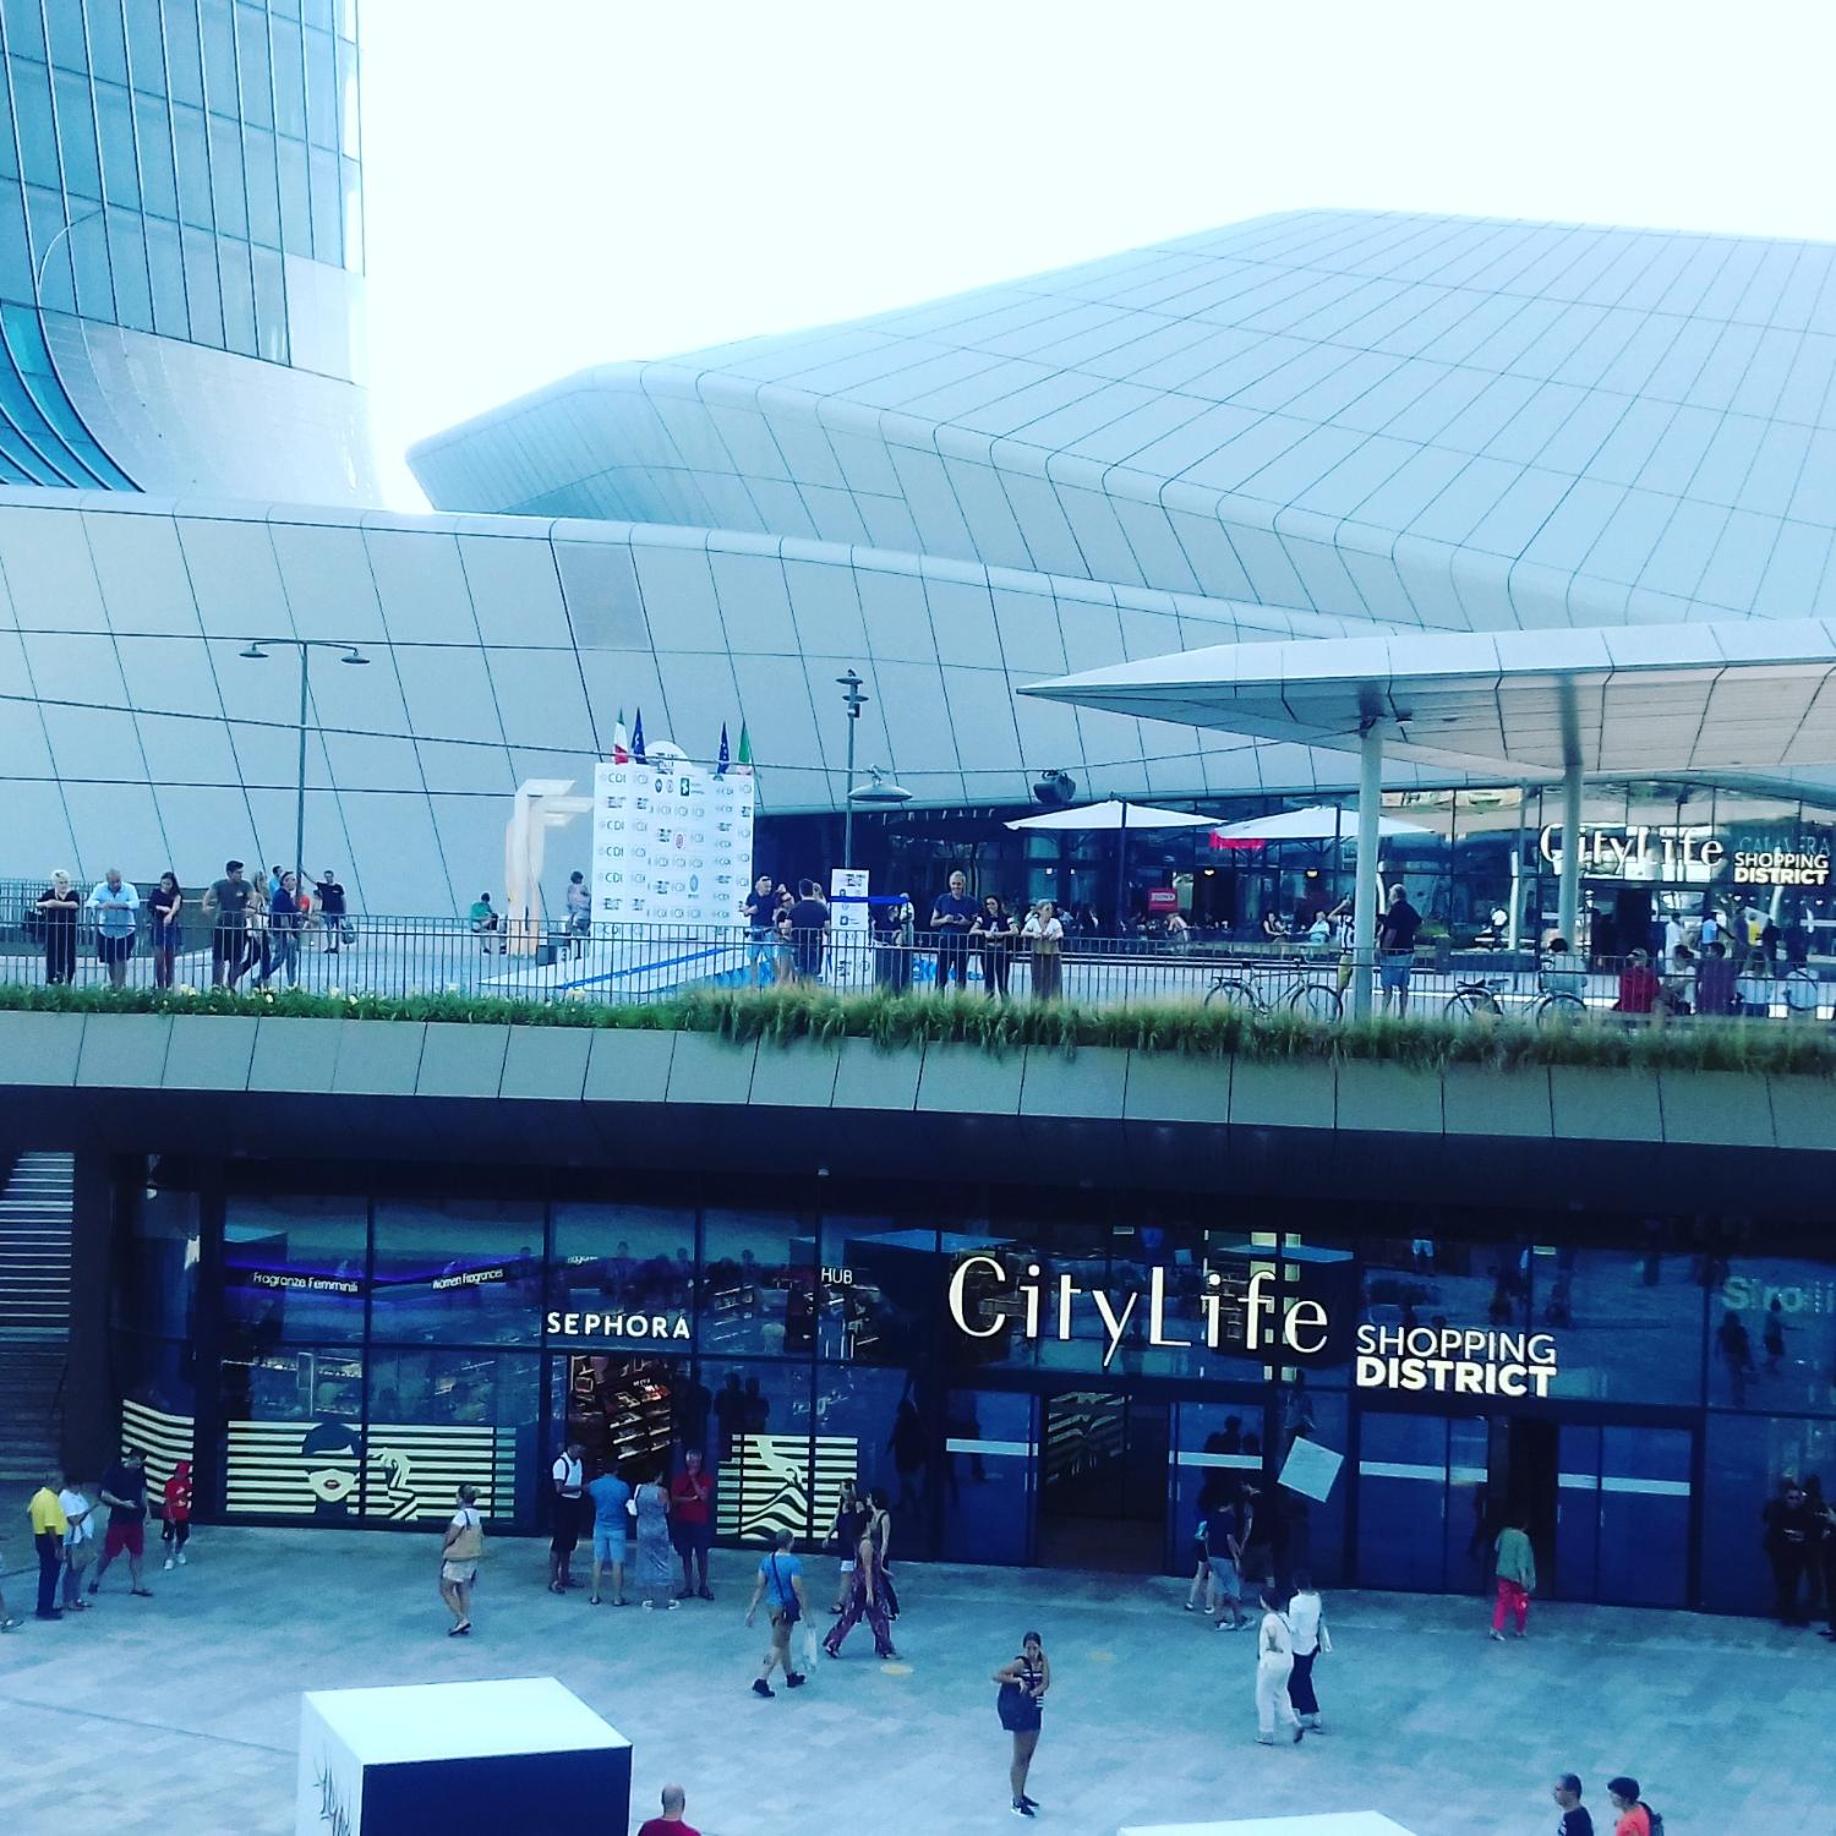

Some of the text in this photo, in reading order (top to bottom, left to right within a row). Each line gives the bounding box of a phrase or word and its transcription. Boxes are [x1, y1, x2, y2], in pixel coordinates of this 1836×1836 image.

[1540, 824, 1724, 873] CityLife
[1734, 851, 1829, 868] SHOPPING
[1739, 836, 1831, 857] CALVERA
[1734, 867, 1829, 885] DISTRICT
[821, 1266, 853, 1285] HUB
[546, 1311, 691, 1340] SEPHORA
[948, 1256, 1328, 1367] CityLife
[1356, 1323, 1556, 1364] SHOPPING
[1355, 1355, 1557, 1397] DISTRICT
